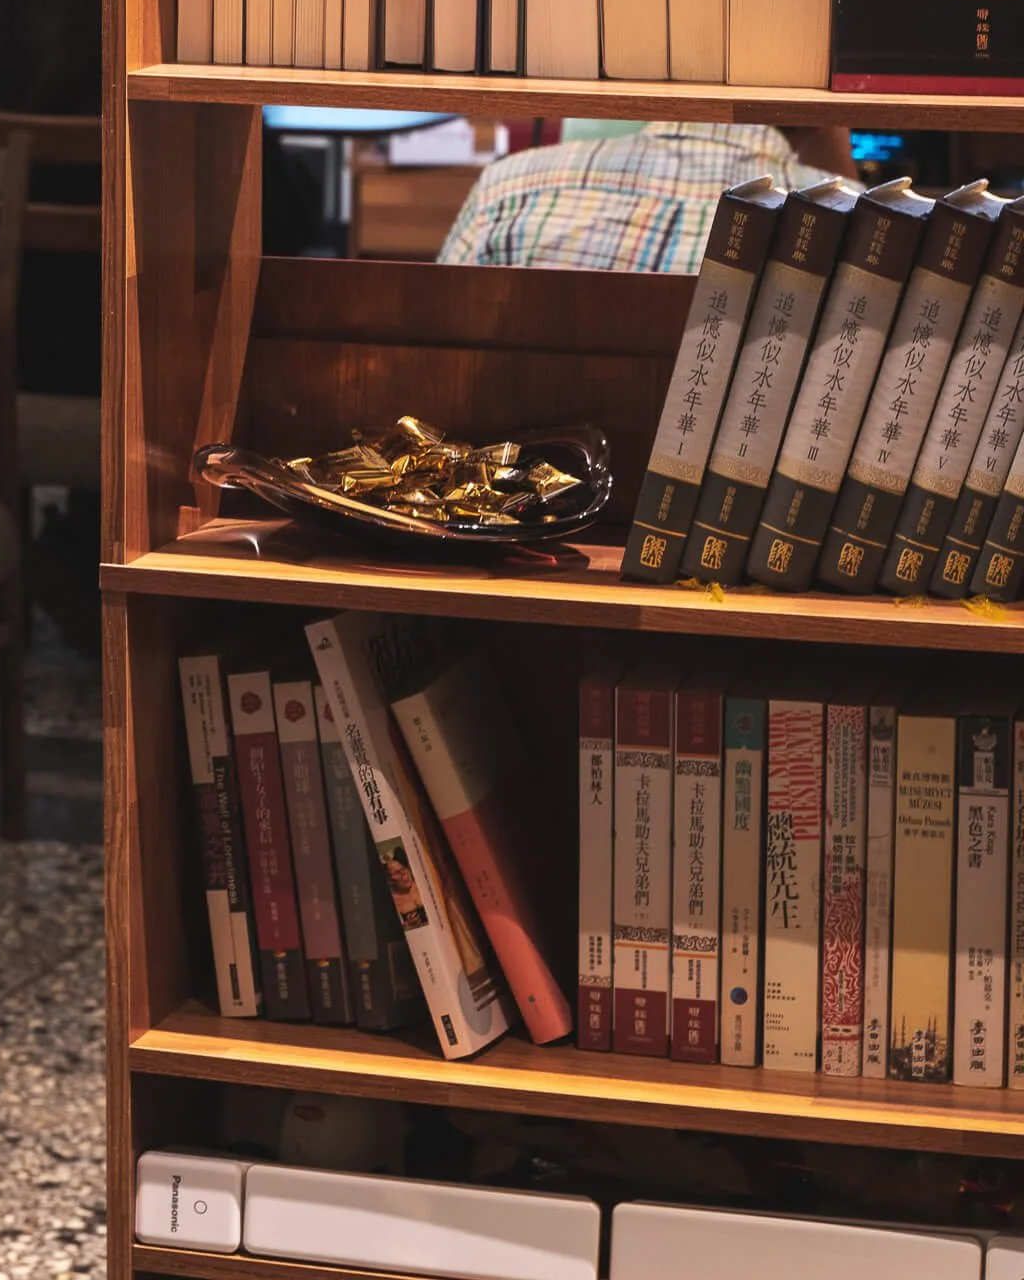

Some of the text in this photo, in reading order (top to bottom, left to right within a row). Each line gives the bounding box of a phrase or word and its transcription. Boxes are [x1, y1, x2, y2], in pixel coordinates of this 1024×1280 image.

[676, 290, 729, 436] 追憶似水年華
[739, 291, 795, 438] 追憶似水年華
[810, 295, 868, 441] 追憶似水年華
[881, 298, 941, 444] 追憶似水年華
[940, 306, 1001, 452] 追憶似水年華
[216, 767, 239, 905] The Well of Loneliness
[344, 722, 389, 826] 名畫真的很有事
[634, 773, 651, 907] 卡拉馬助夫兄弟們
[785, 710, 820, 840] PRESIDENTE
[688, 782, 705, 917] 卡拉馬助夫兄弟們
[767, 812, 801, 929] 總統先生
[170, 1174, 182, 1233] Panasonic
